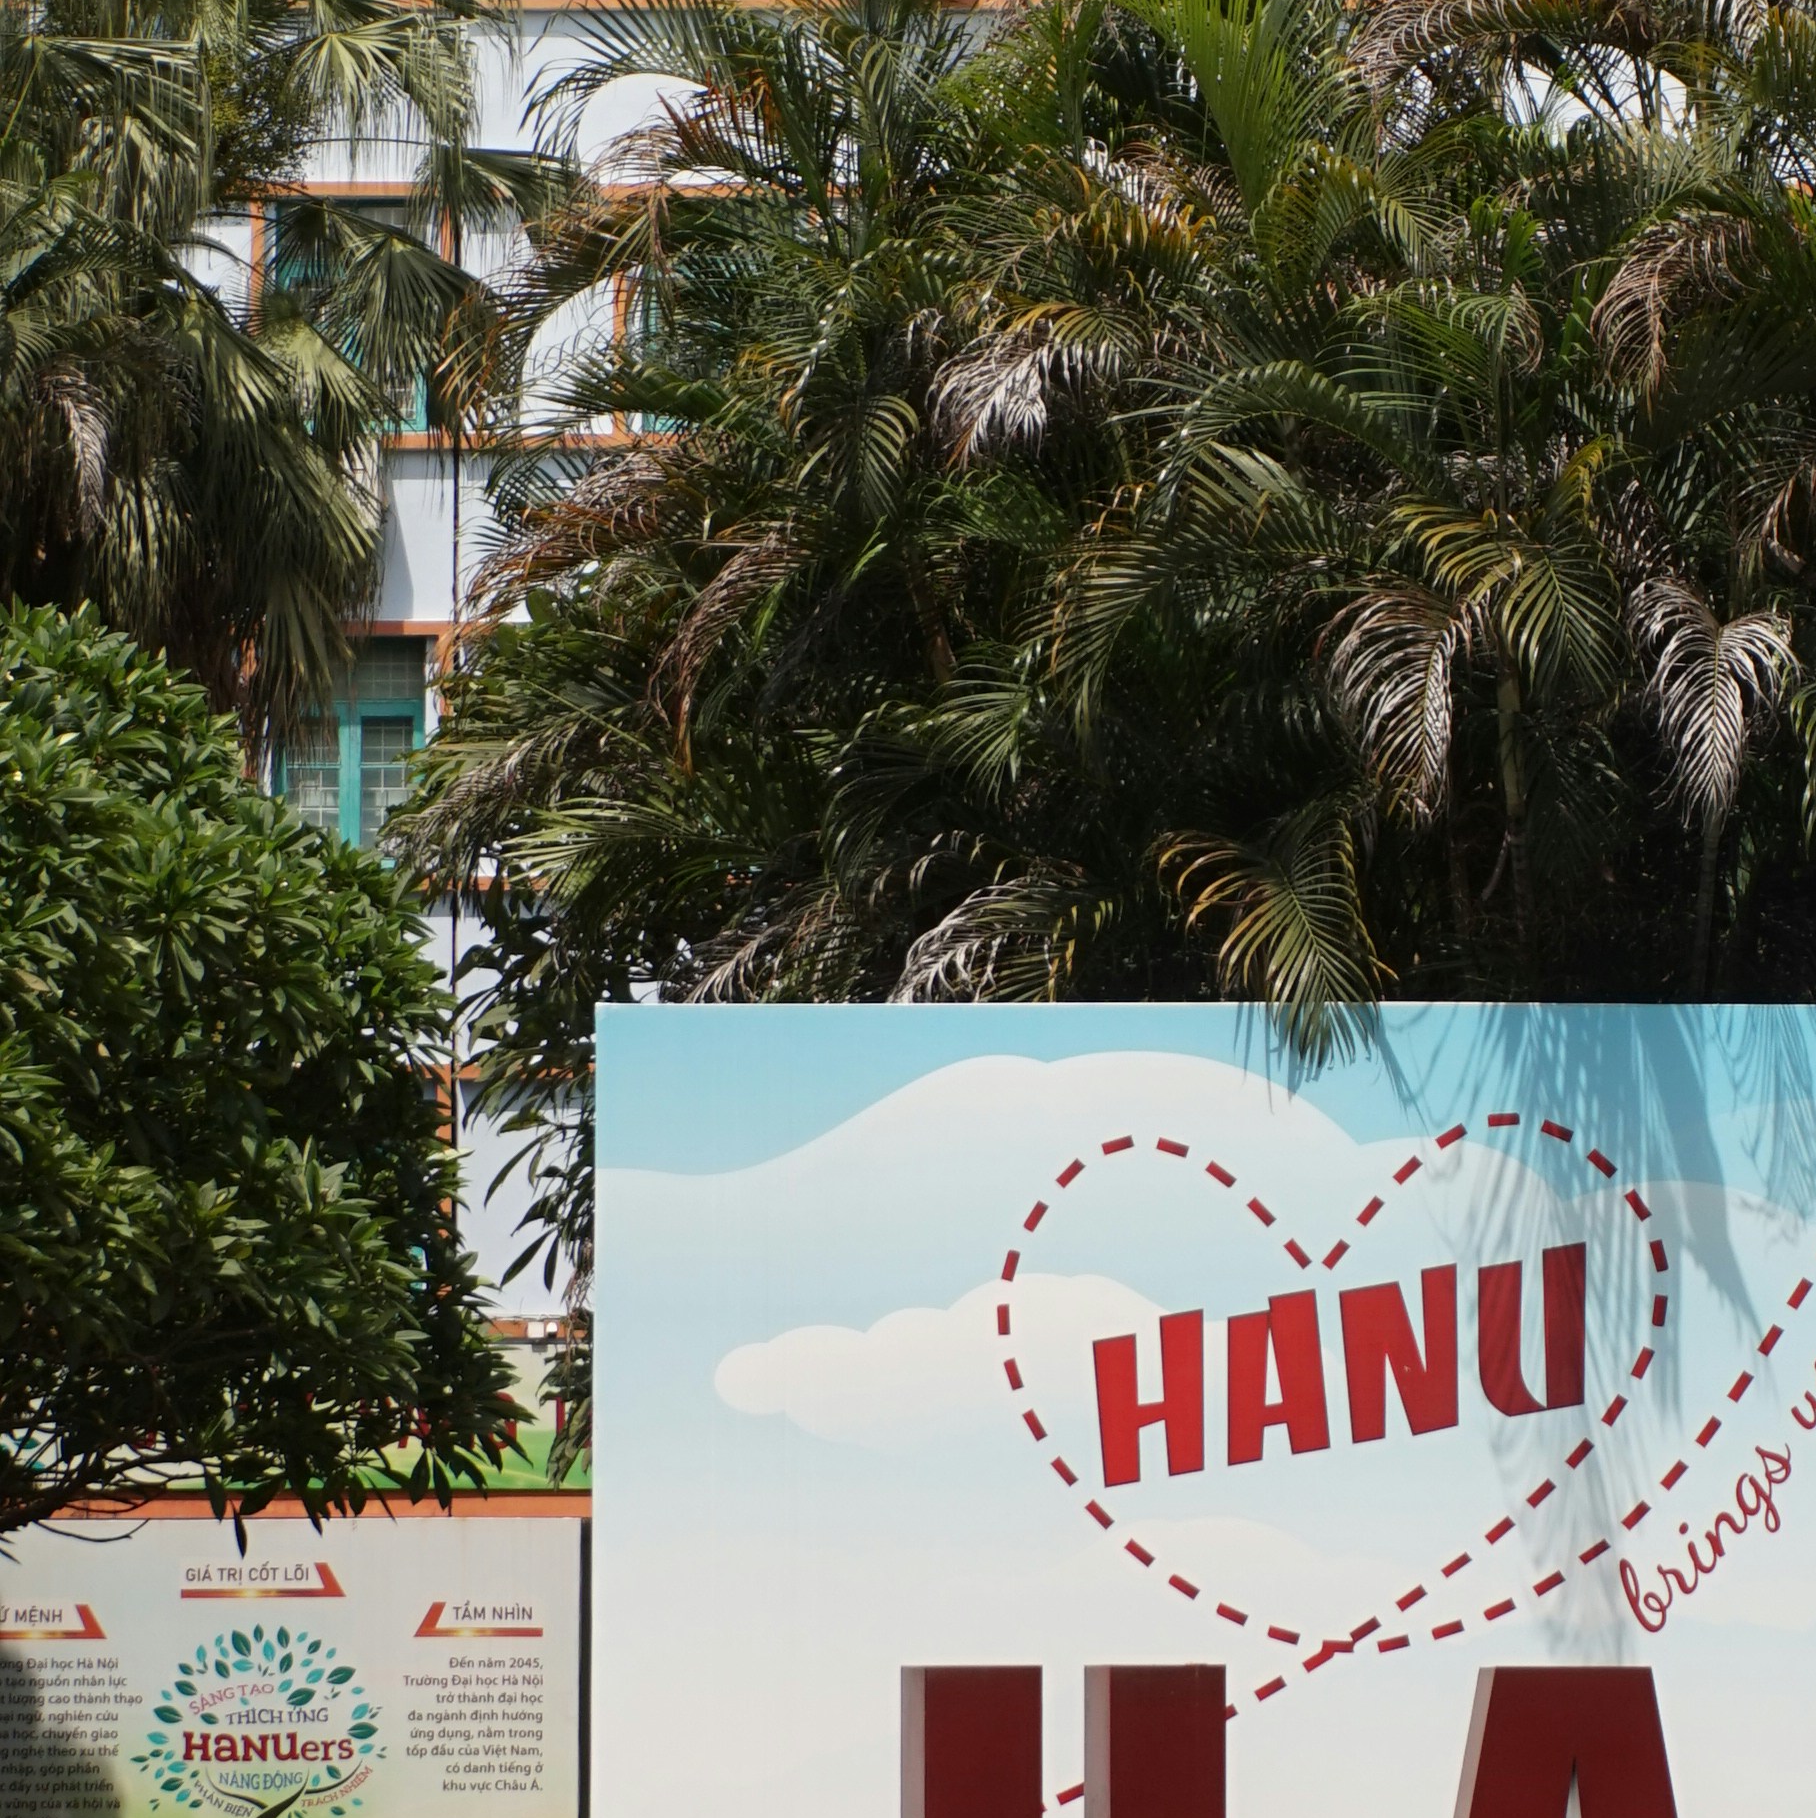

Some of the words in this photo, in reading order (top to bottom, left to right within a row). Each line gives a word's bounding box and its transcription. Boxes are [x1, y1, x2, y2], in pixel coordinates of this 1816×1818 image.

[1092, 1241, 1587, 1489] HANU
[1619, 1442, 1792, 1633] brings
[185, 1564, 212, 1582] GIÁ
[217, 1567, 243, 1586] TRỊ
[248, 1562, 279, 1582] CỐT
[284, 1563, 310, 1582] LÕI
[14, 1605, 63, 1626] MỆNH
[452, 1600, 486, 1621] TẦM
[492, 1602, 534, 1621] NHÌN
[51, 1656, 74, 1671] học
[77, 1657, 93, 1669] Hà
[97, 1657, 119, 1671] Nội
[449, 1655, 474, 1669] Đến
[478, 1657, 505, 1669] năm
[509, 1656, 543, 1670] 2045,
[403, 1674, 448, 1688] Trường
[451, 1675, 472, 1688] Đại
[475, 1675, 498, 1688] học
[502, 1674, 518, 1686] Hà
[522, 1674, 543, 1688] Nội
[48, 1695, 71, 1704] cao
[435, 1692, 455, 1703] trở
[457, 1692, 494, 1703] thành
[497, 1692, 517, 1706] đại
[520, 1692, 544, 1705] học
[225, 1707, 283, 1726] THÍCH
[407, 1710, 423, 1721] đa
[426, 1710, 467, 1724] ngành
[470, 1710, 498, 1723] định
[501, 1710, 543, 1724] hướng
[91, 1727, 118, 1742] giao
[410, 1727, 434, 1741] ứng
[438, 1727, 474, 1741] dụng,
[508, 1728, 543, 1741] trong
[48, 1745, 77, 1756] theo
[80, 1748, 94, 1756] xu
[406, 1743, 428, 1758] tốp
[457, 1743, 480, 1756] của
[482, 1744, 507, 1758] Việt
[510, 1745, 543, 1757] Nam,
[445, 1761, 460, 1774] có
[463, 1761, 495, 1774] danh
[499, 1760, 531, 1776] tiếng
[442, 1779, 466, 1791] khu
[469, 1781, 492, 1794] vực
[494, 1779, 527, 1791] Châu
